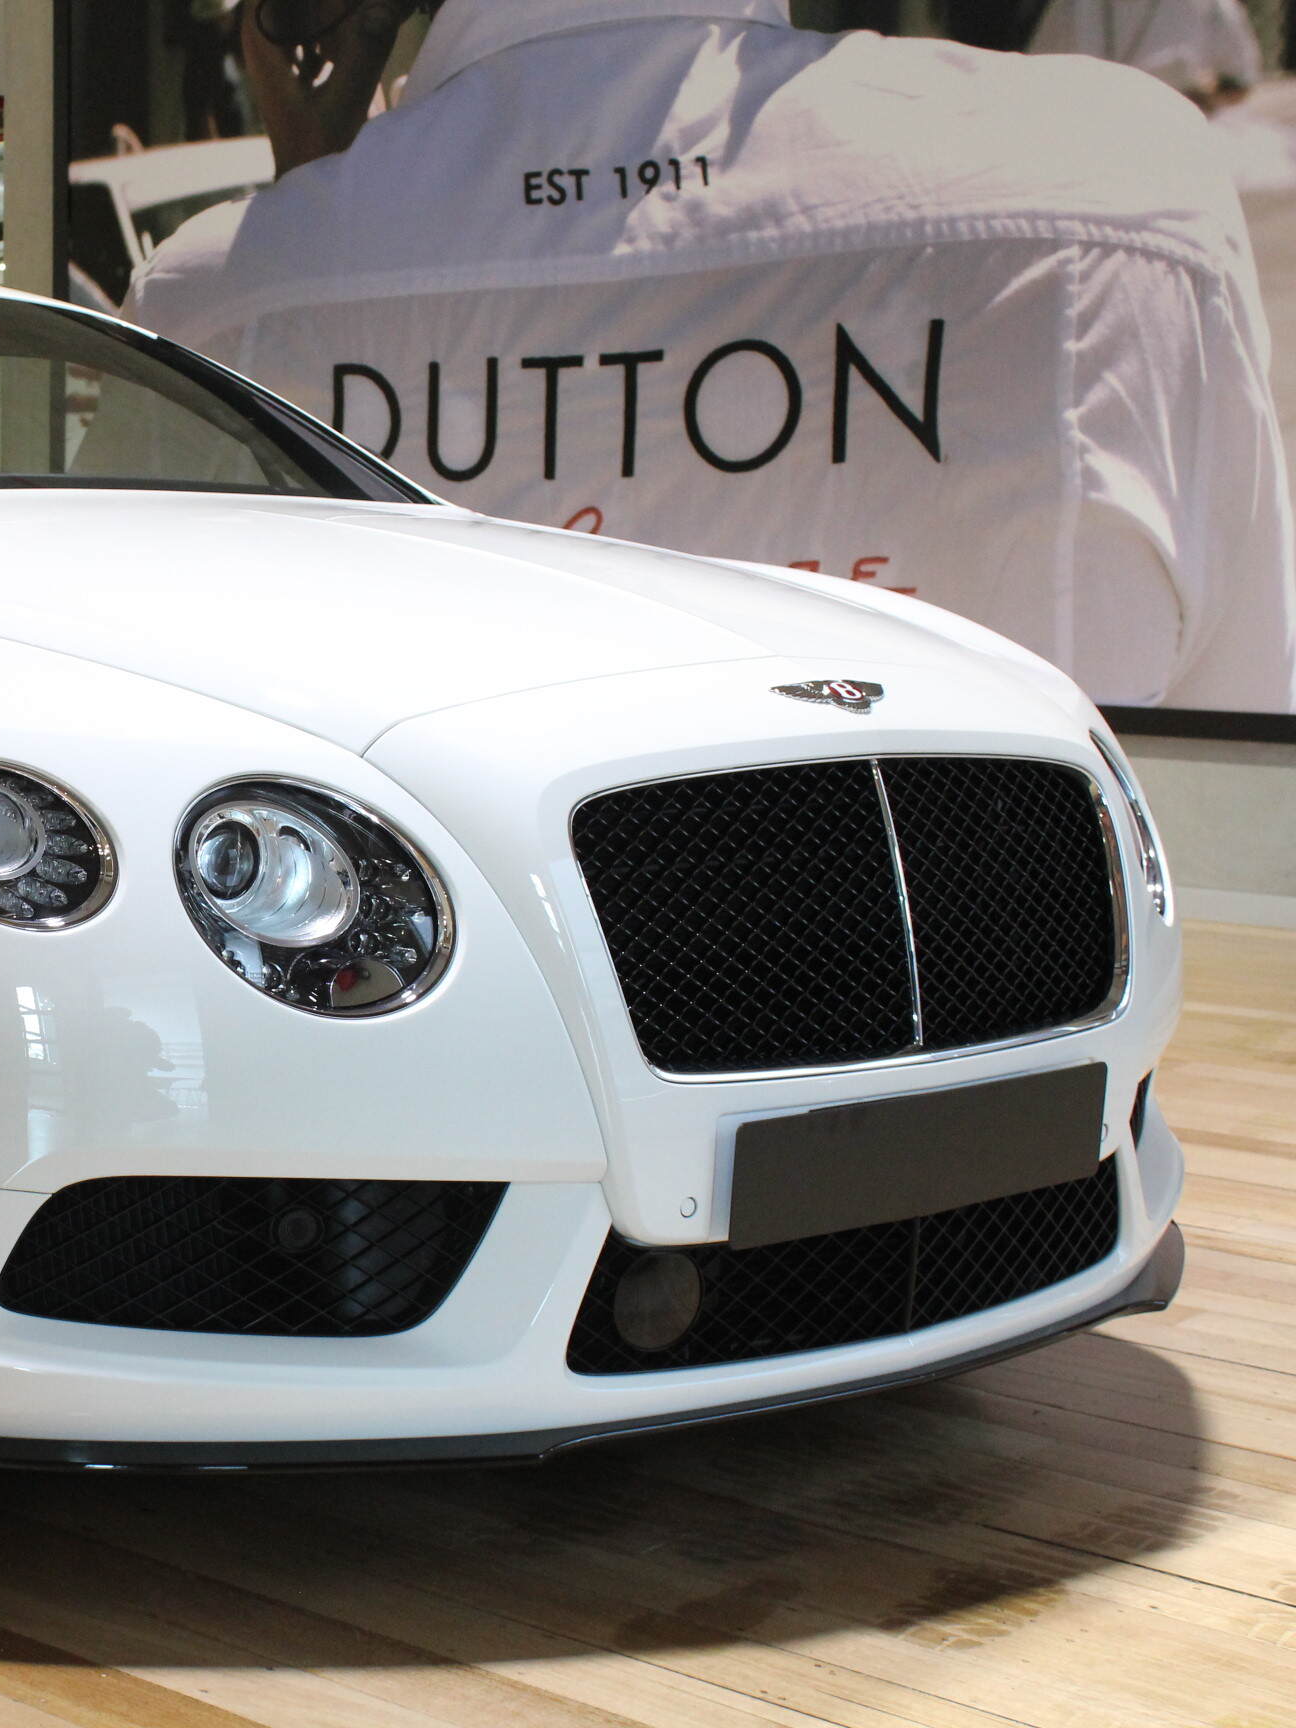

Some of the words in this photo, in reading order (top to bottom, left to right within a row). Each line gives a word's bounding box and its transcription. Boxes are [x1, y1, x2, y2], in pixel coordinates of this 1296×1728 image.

[524, 167, 591, 206] EST
[613, 155, 709, 199] 1911
[332, 317, 945, 482] DUTTON
